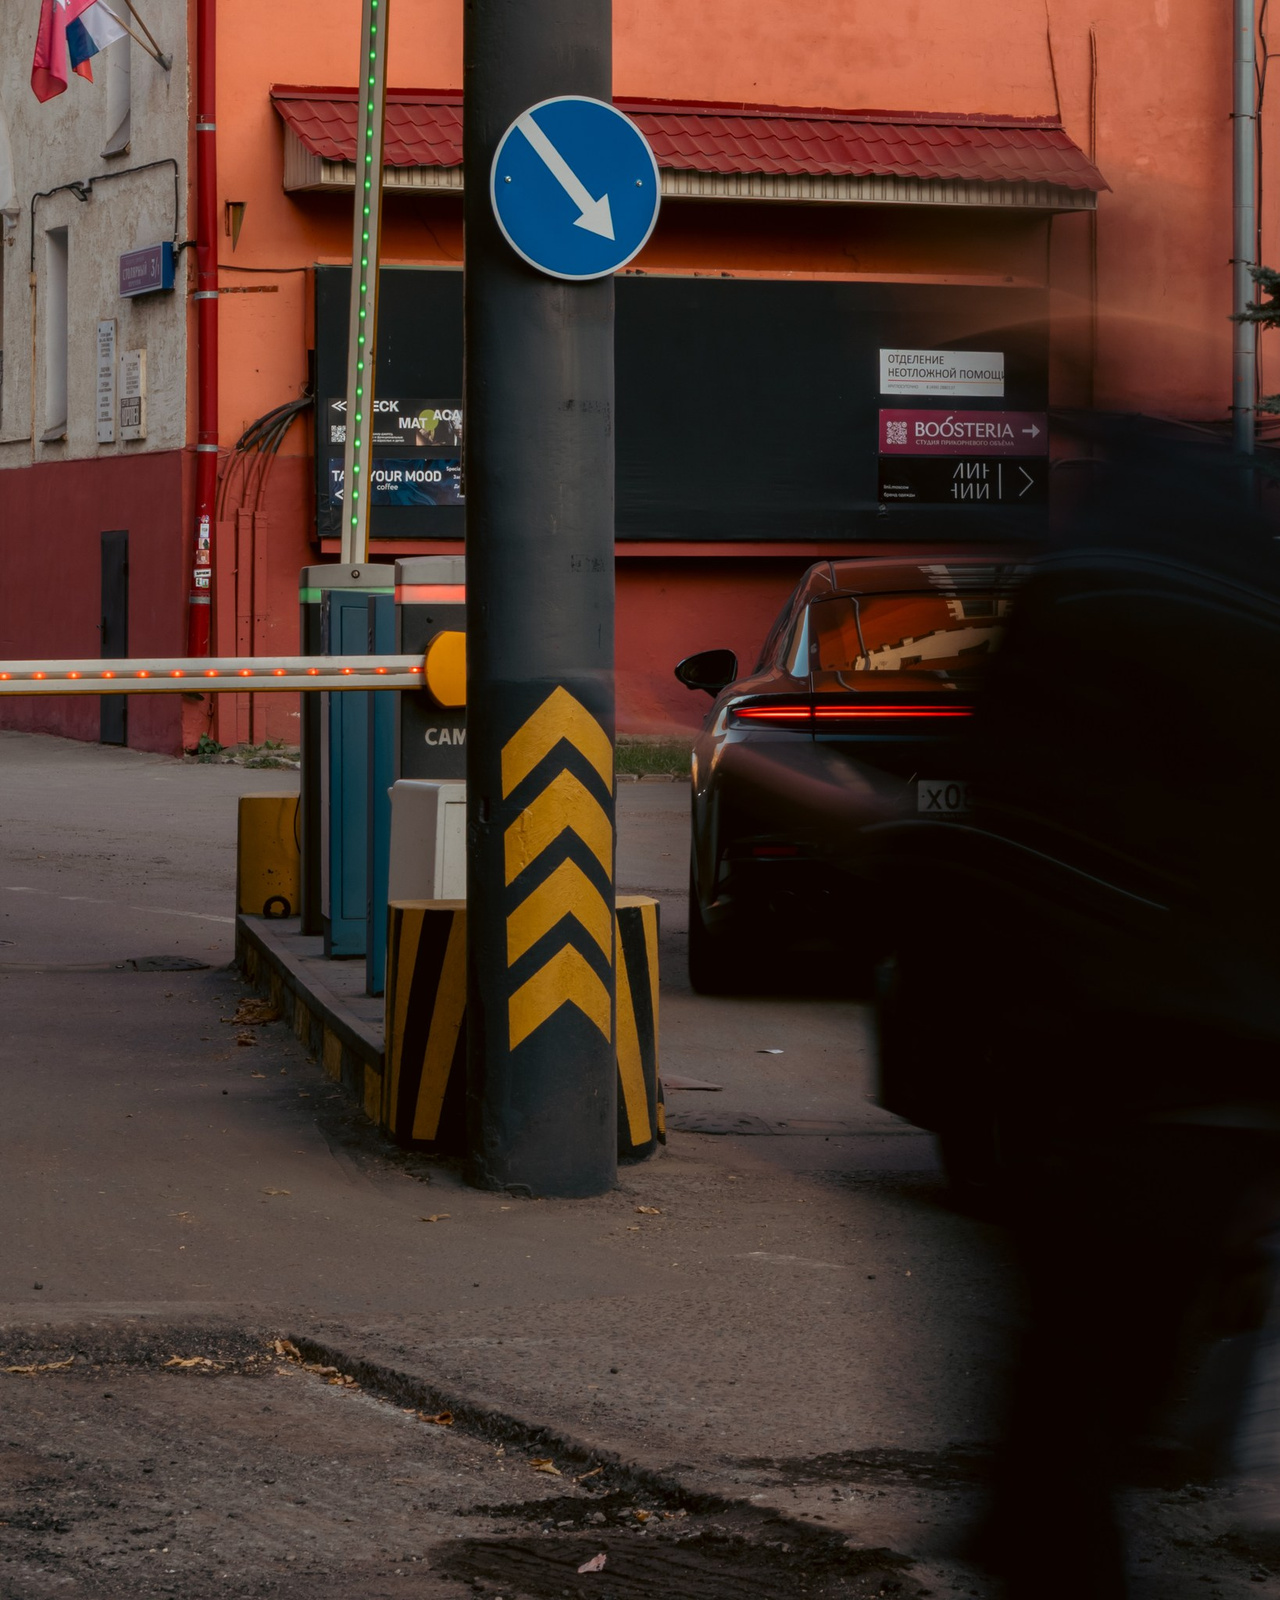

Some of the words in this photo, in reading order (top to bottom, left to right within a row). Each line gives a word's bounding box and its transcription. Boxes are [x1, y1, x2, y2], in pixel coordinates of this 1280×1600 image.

[887, 354, 944, 365] ОТДЕЛЕНИЕ
[888, 367, 957, 379] НЕОТЛОЖНОЙ
[398, 417, 428, 429] MAT
[405, 470, 442, 482] MOOD
[376, 483, 399, 491] coffee
